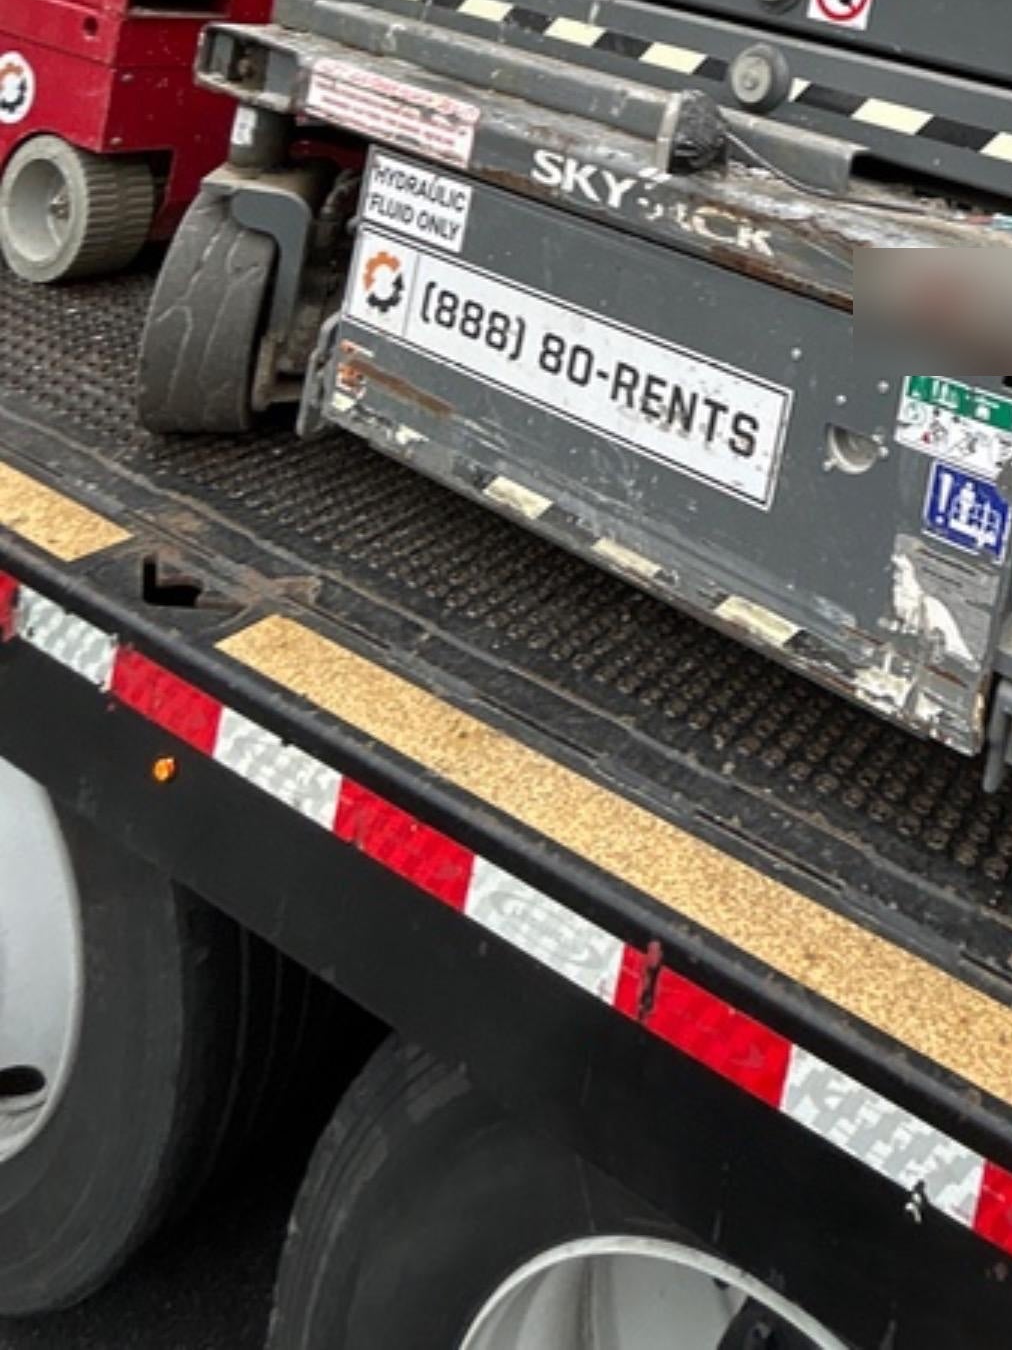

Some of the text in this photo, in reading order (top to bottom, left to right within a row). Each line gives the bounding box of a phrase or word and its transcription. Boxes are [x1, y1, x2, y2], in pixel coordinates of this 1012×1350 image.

[373, 161, 467, 213] HYDRAULIC
[368, 193, 460, 241] FLUID ONLY
[420, 280, 761, 458] (888) 80-RENTS
